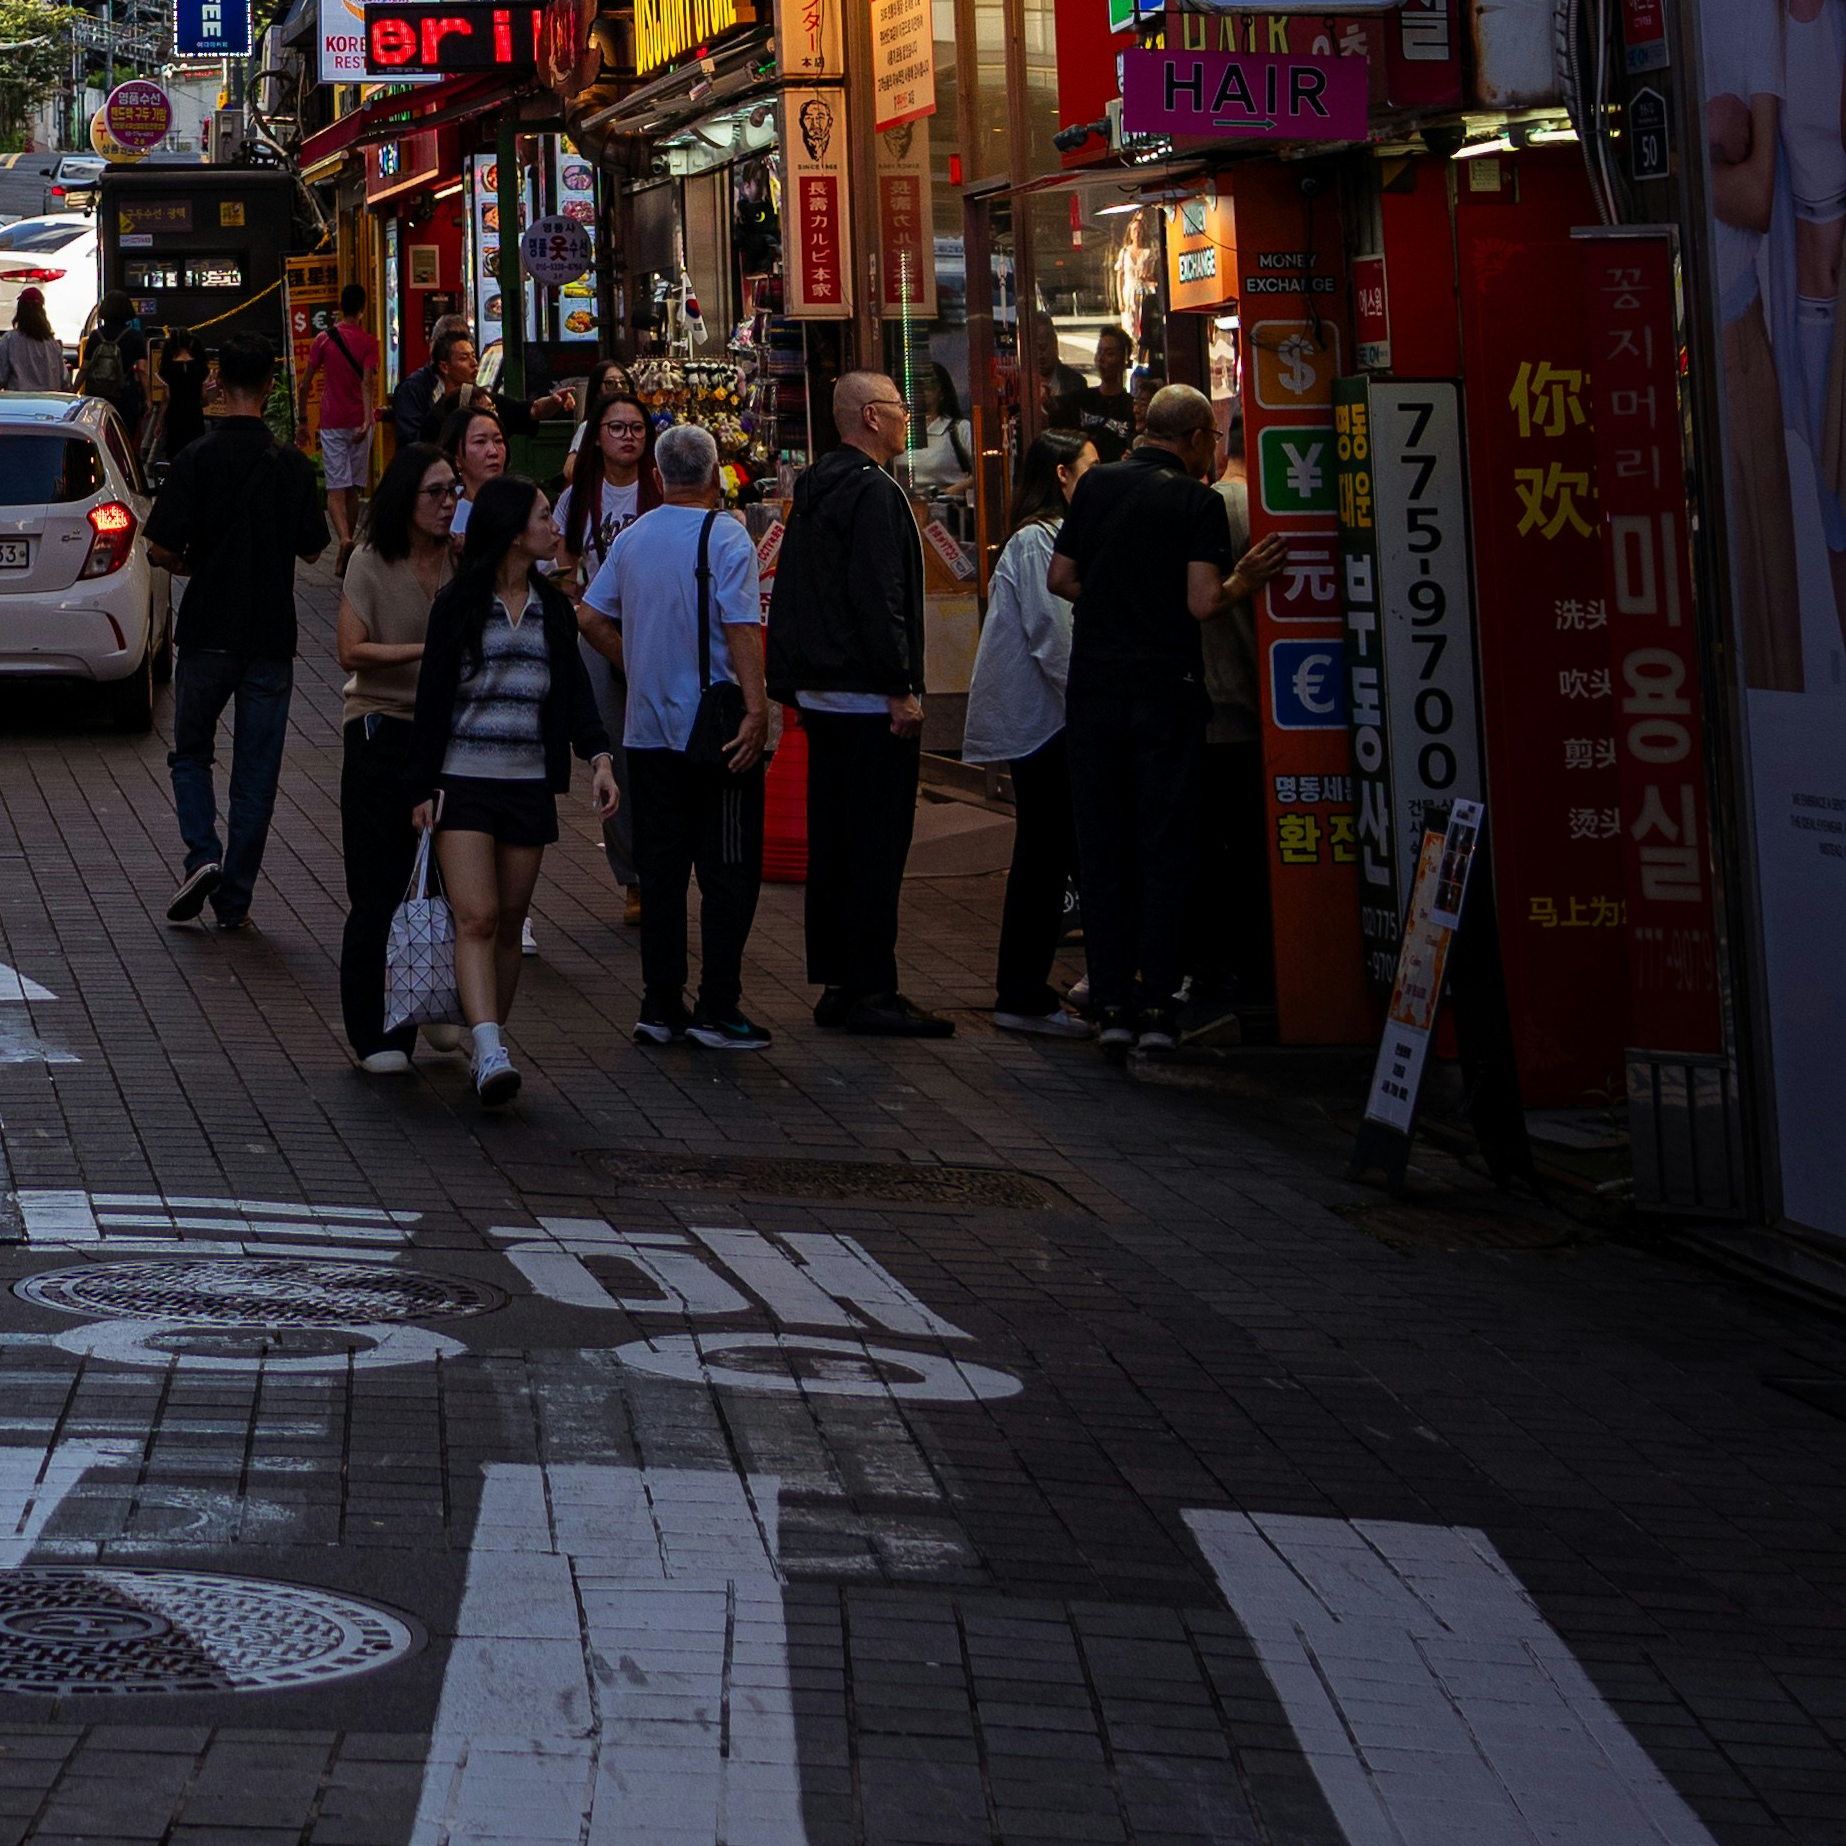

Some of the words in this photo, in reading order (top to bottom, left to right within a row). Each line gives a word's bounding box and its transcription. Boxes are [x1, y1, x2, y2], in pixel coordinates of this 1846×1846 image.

[1163, 61, 1330, 118] HAIR
[1259, 252, 1318, 269] MONEY
[1335, 402, 1367, 461] 명동
[1600, 267, 1660, 492] 꽁지머리
[1397, 403, 1456, 790] 775-9700
[1342, 555, 1390, 887] 부동산
[1611, 512, 1703, 903] 미용실
[1634, 925, 1713, 994] 777-9079
